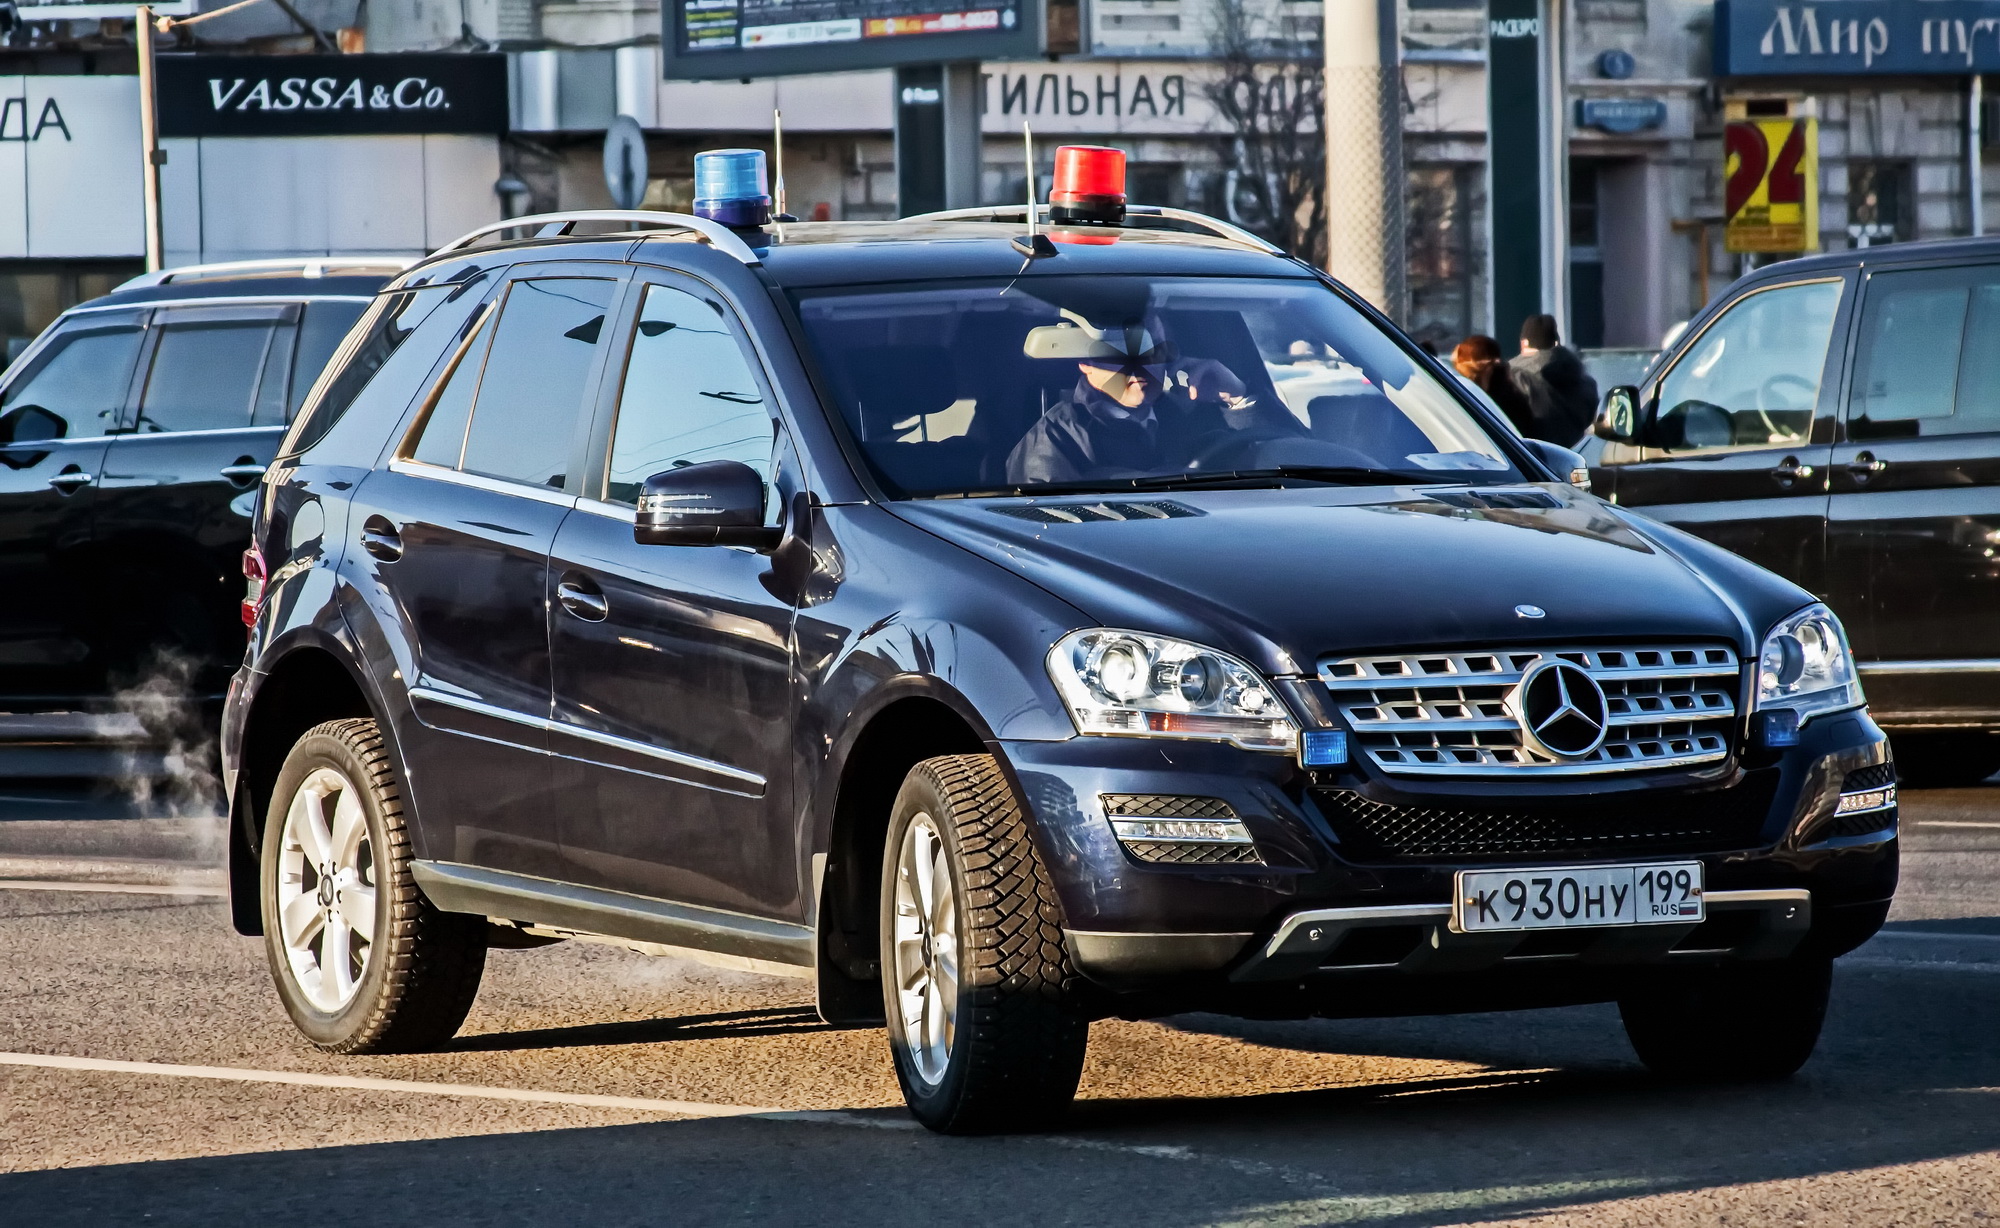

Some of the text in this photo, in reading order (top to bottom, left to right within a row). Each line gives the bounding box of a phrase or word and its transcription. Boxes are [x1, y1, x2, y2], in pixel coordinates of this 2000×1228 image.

[1760, 7, 1888, 68] Мир
[208, 77, 450, 111] VASSA&Co.
[0, 97, 71, 142] ДА
[1726, 119, 1805, 224] 24
[1478, 869, 1692, 923] К930НУ 199
[1652, 903, 1678, 916] RUS
